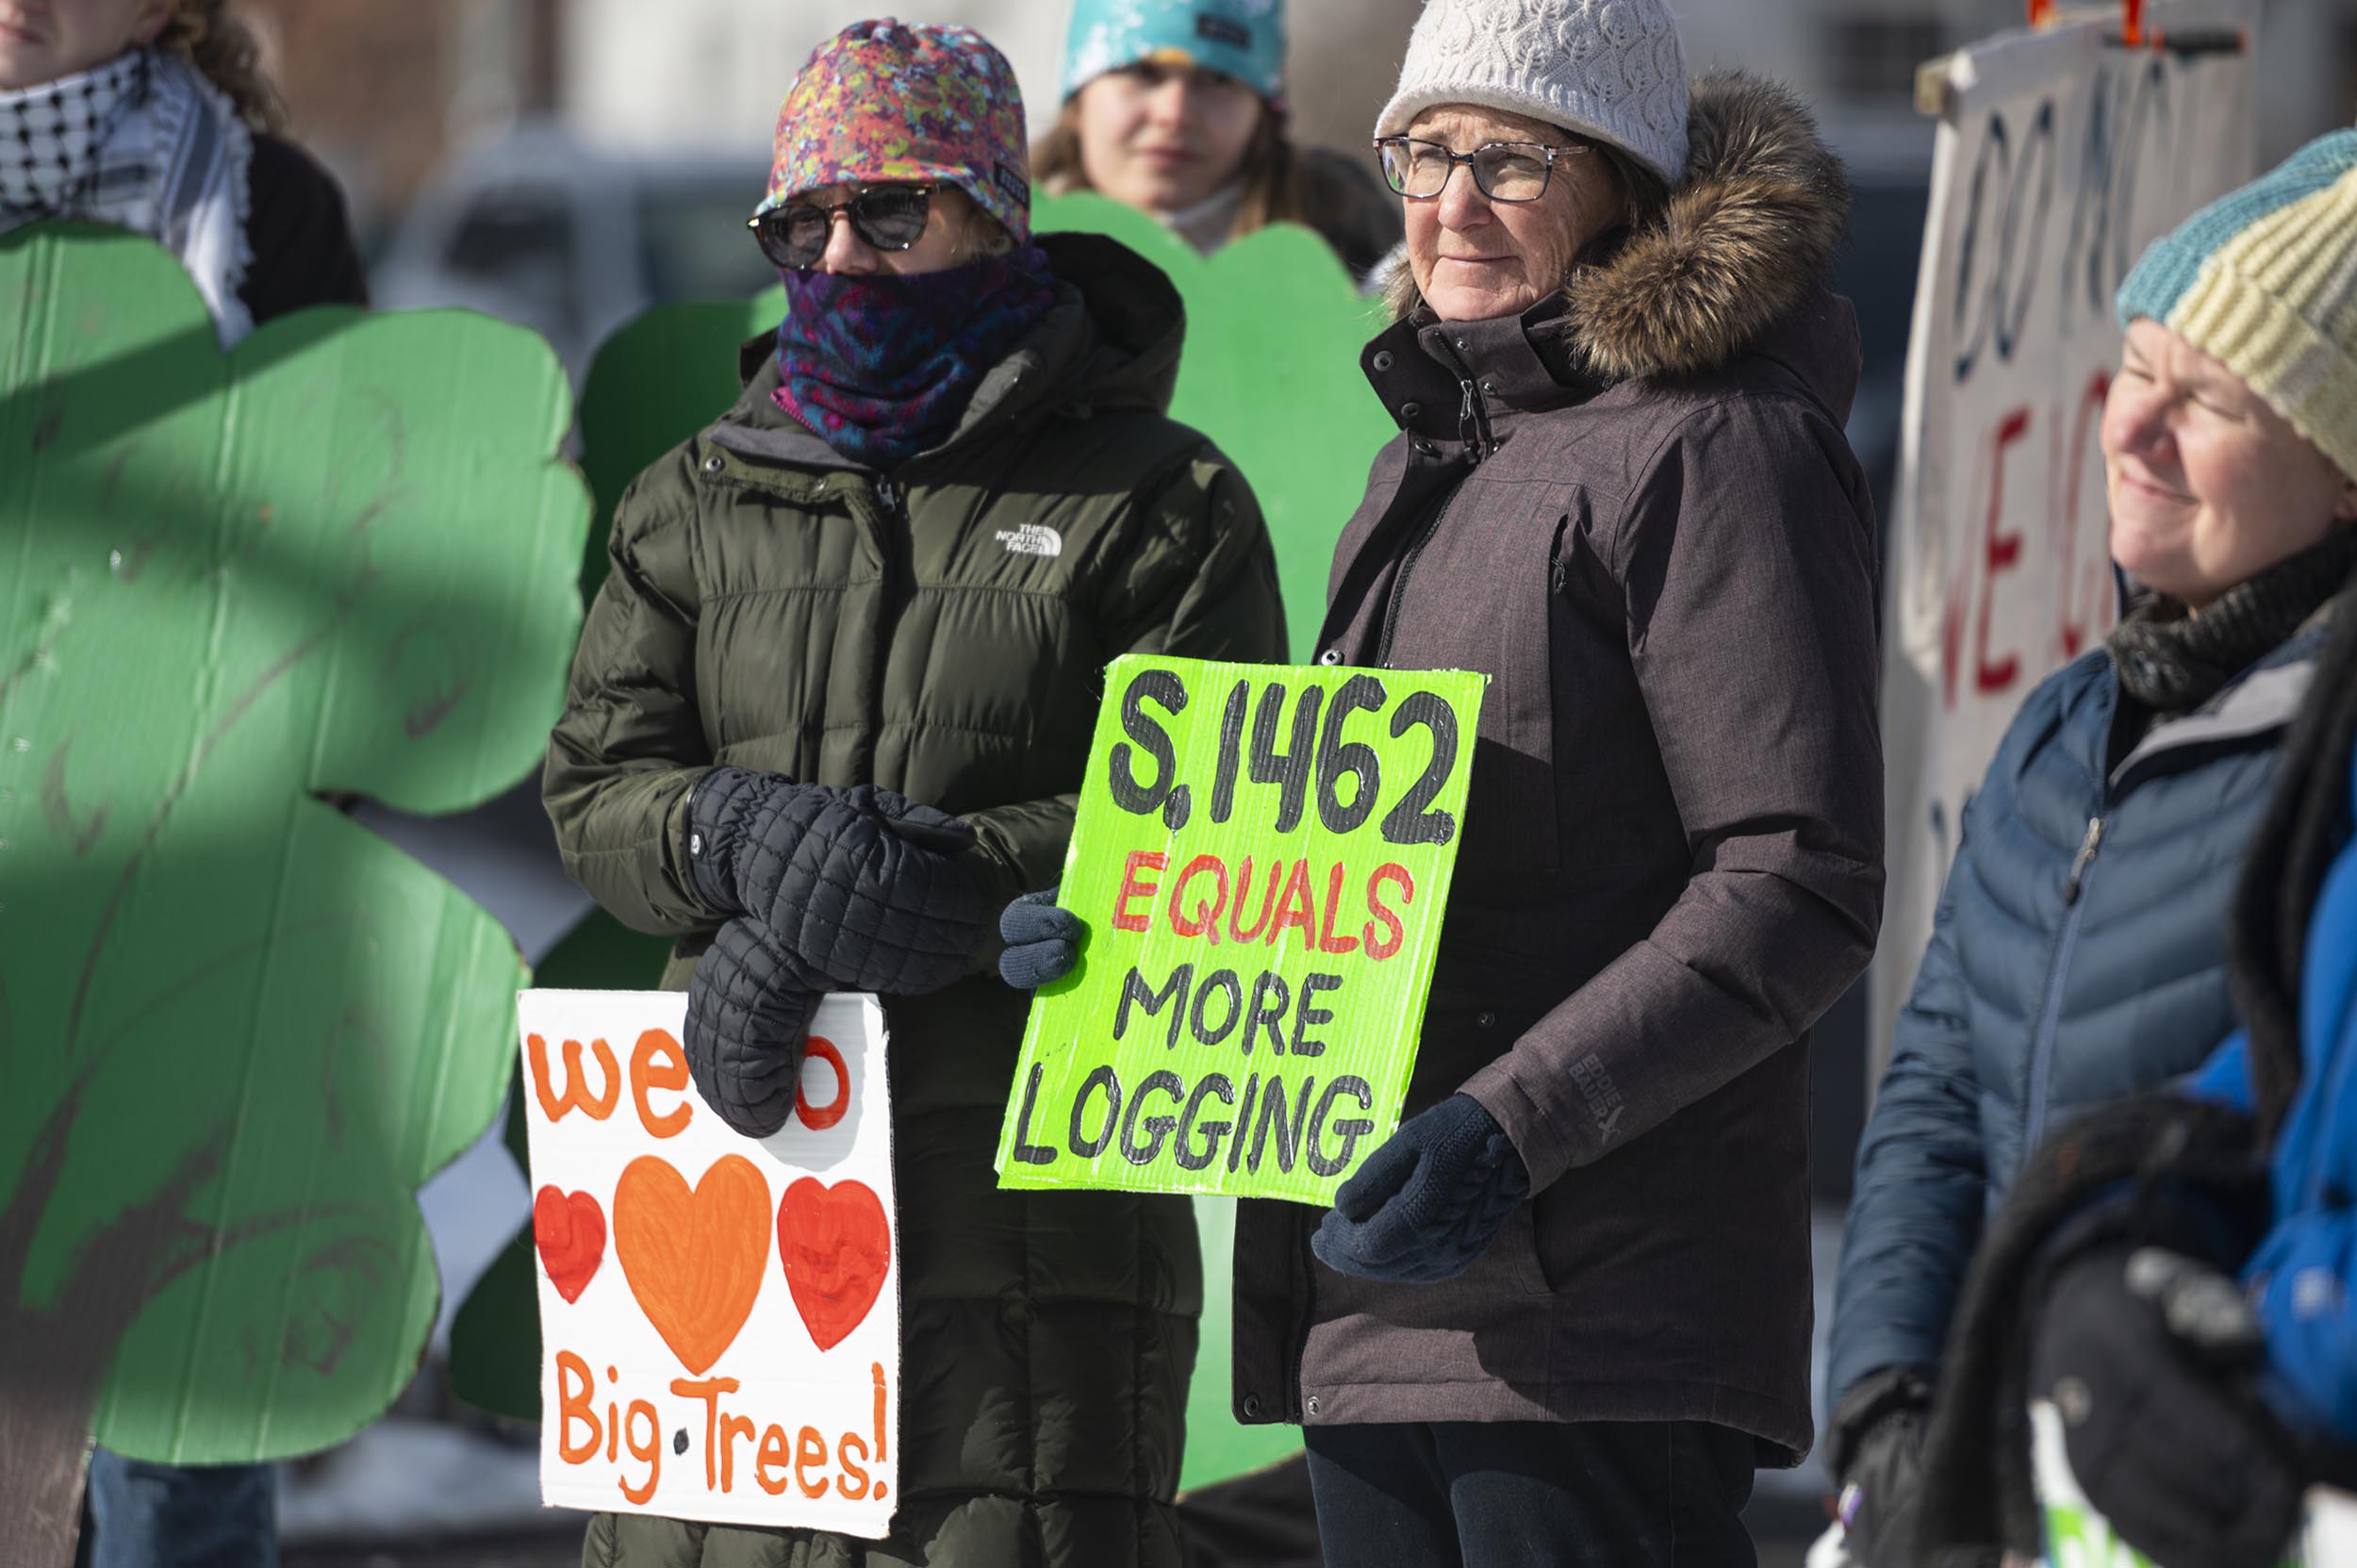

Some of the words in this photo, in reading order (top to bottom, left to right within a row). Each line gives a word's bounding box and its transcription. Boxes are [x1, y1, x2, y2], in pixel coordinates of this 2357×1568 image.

[996, 530, 1042, 545] NORTH
[1006, 541, 1038, 554] FACE
[1019, 522, 1045, 536] THE
[1112, 850, 1415, 962] EQUALS
[1113, 963, 1343, 1057] MORE
[527, 1028, 693, 1139] we
[1568, 1063, 1608, 1121] BAUER
[1582, 1052, 1622, 1108] EDDIE
[1013, 1061, 1375, 1177] LOGGING
[556, 1350, 662, 1506] Big
[669, 1362, 887, 1501] Trees!
